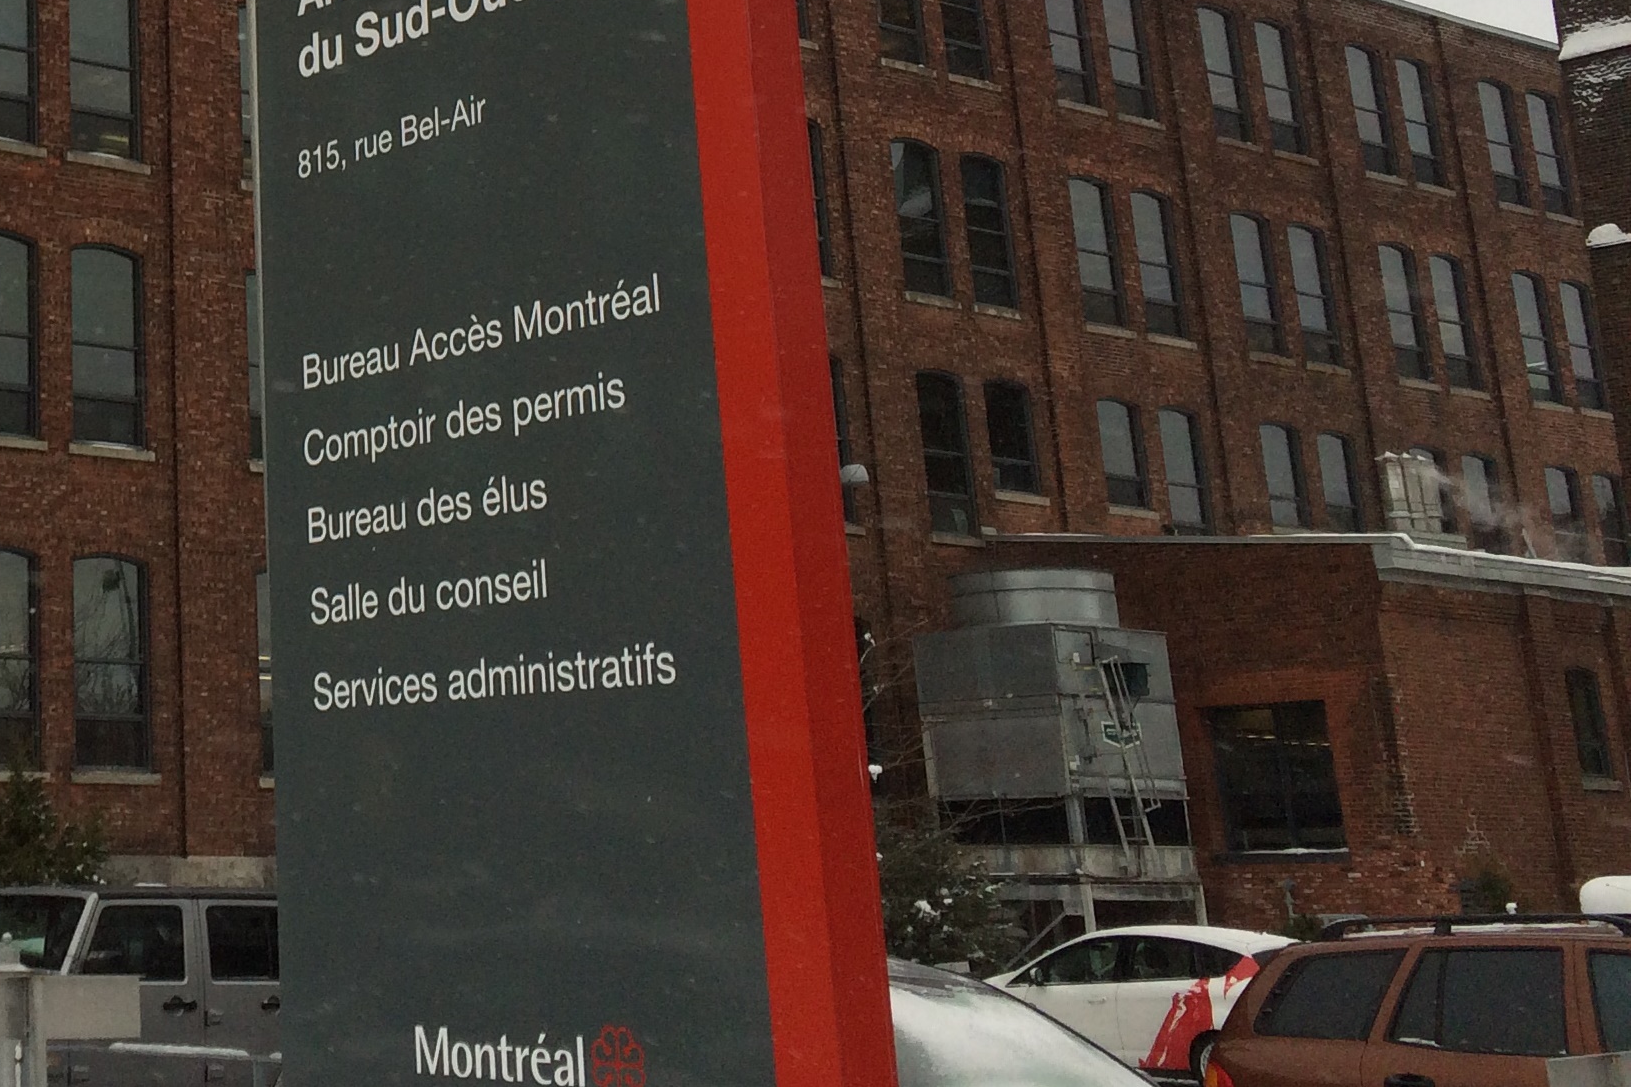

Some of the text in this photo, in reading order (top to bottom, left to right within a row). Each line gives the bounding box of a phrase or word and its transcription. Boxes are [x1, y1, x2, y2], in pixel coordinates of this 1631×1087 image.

[298, 31, 344, 79] du
[297, 96, 487, 179] 815, rue Bel-Air
[302, 272, 661, 390] Bureau Accès Montréal
[303, 371, 627, 466] Comptoir des permis
[307, 475, 549, 544] Bureau des élus
[310, 558, 549, 625] Salle du conseil
[313, 642, 678, 711] Services administratifs
[414, 1024, 586, 1087] Montréal
